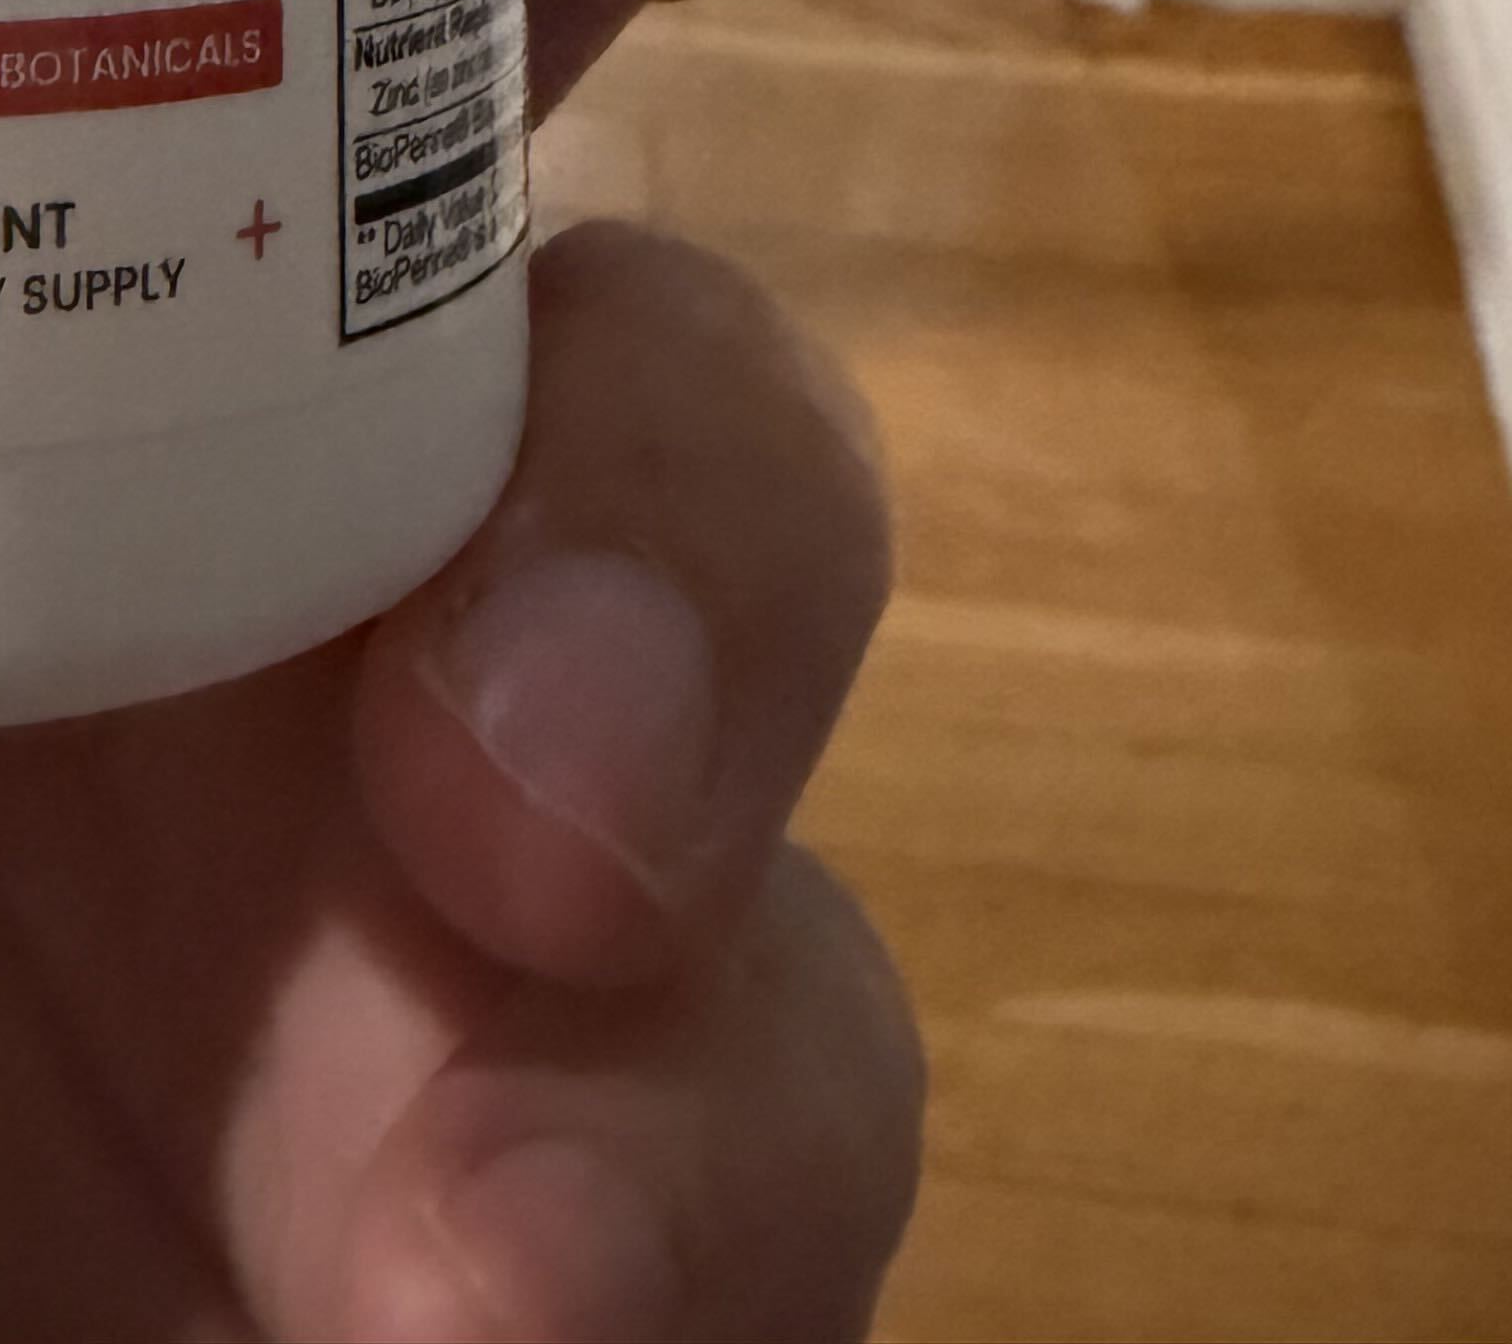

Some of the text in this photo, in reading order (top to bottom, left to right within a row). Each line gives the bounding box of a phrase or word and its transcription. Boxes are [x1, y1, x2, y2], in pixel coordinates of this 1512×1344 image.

[0, 28, 262, 90] BOTANICALS
[369, 76, 419, 116] Zinc
[22, 257, 187, 317] SUPPLY
